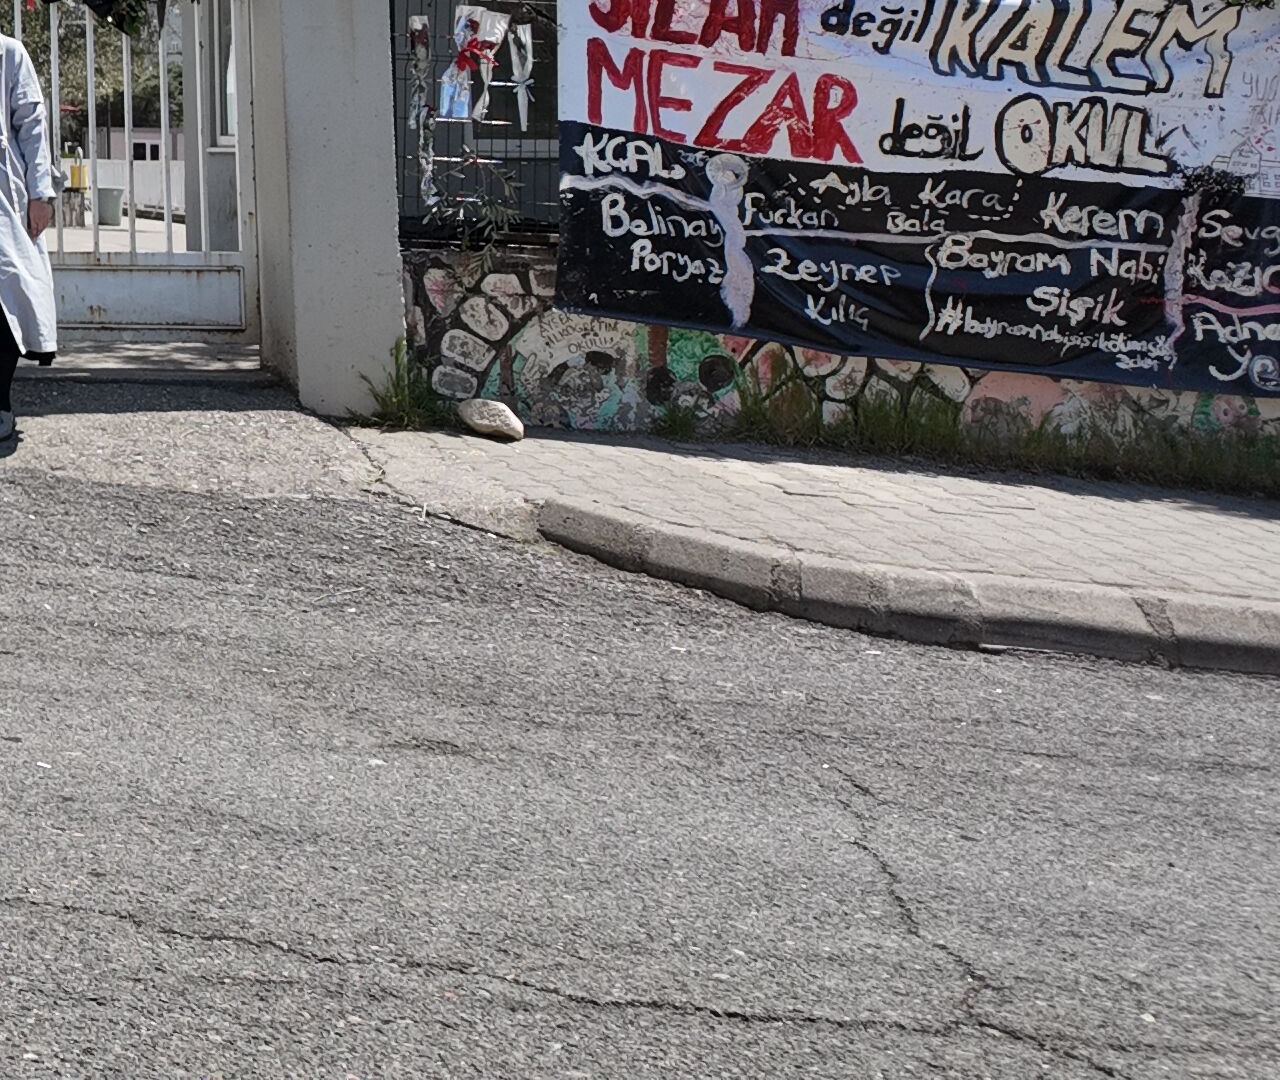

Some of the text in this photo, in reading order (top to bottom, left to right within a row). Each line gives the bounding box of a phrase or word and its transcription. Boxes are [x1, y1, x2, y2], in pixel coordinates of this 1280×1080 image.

[587, 37, 864, 164] MEZAR
[878, 97, 984, 162] değil
[993, 91, 1176, 178] OKUL
[918, 178, 1004, 209] Kara
[1039, 190, 1165, 241] Kerem
[601, 193, 725, 248] Belinay
[1198, 208, 1280, 258] Sevg
[760, 248, 903, 292] Zeynep
[938, 234, 1167, 285] Bayram Nabi
[1191, 311, 1280, 344] Adna
[1208, 344, 1280, 392] Ye
